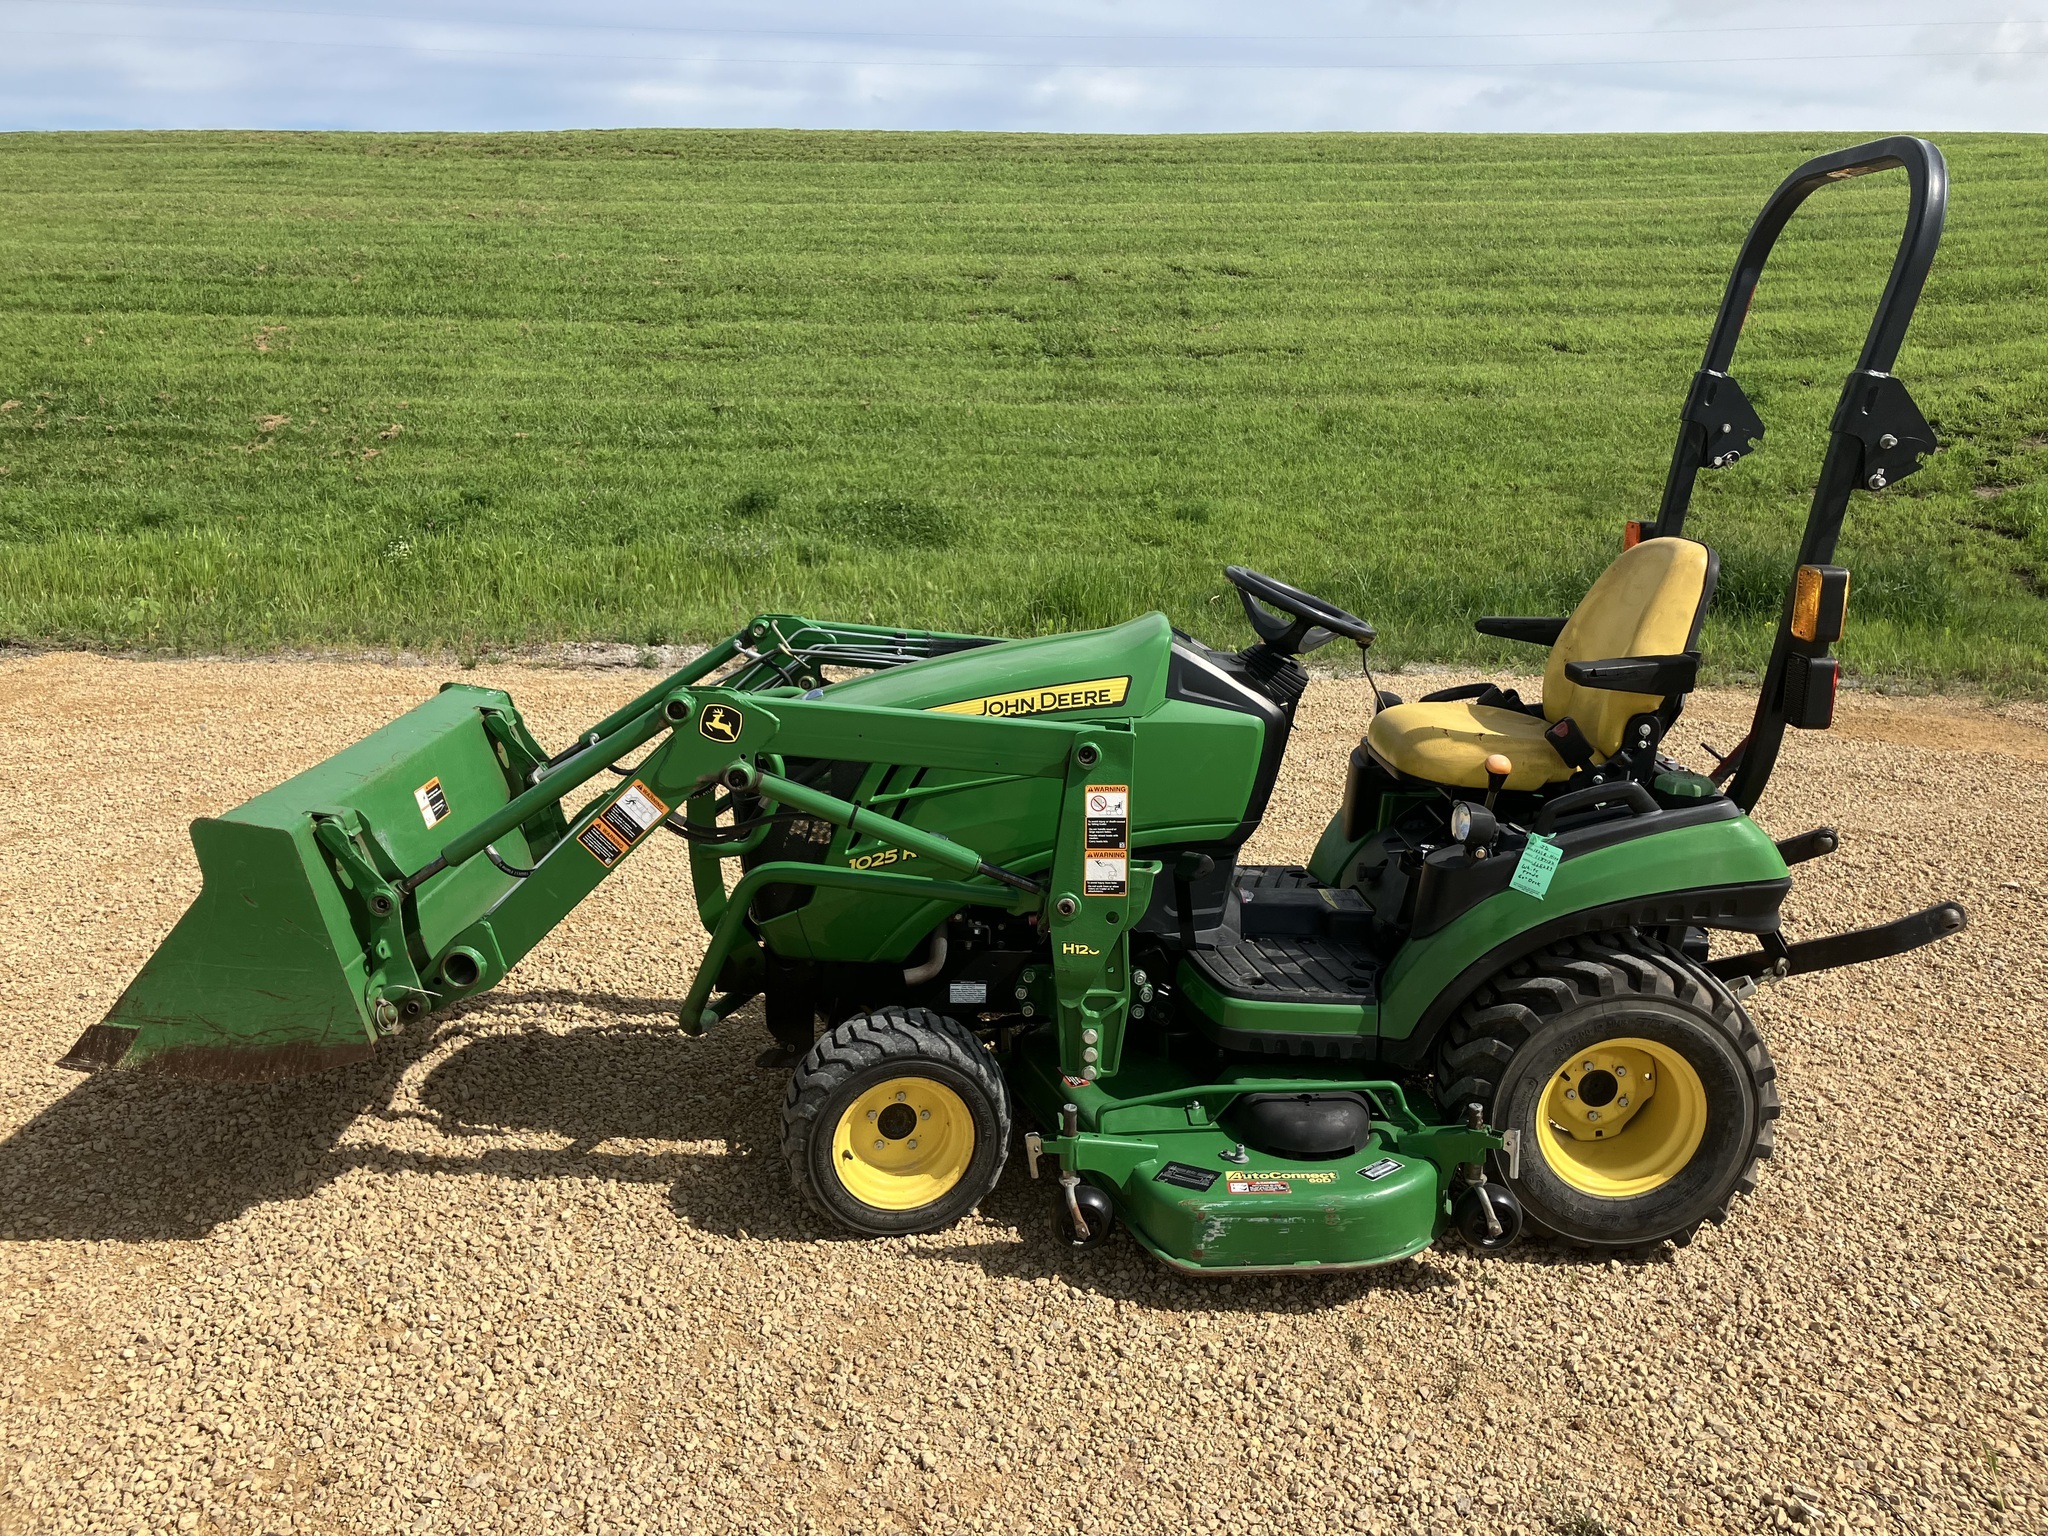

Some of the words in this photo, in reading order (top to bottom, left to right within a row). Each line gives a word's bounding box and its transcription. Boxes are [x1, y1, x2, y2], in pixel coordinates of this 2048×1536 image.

[977, 697, 1035, 716] JOHN
[1040, 689, 1111, 709] DEERE
[643, 789, 664, 810] WARNING
[602, 828, 624, 849] WARNING
[849, 849, 898, 870] 1025
[1228, 1171, 1337, 1180] AutoConnect
